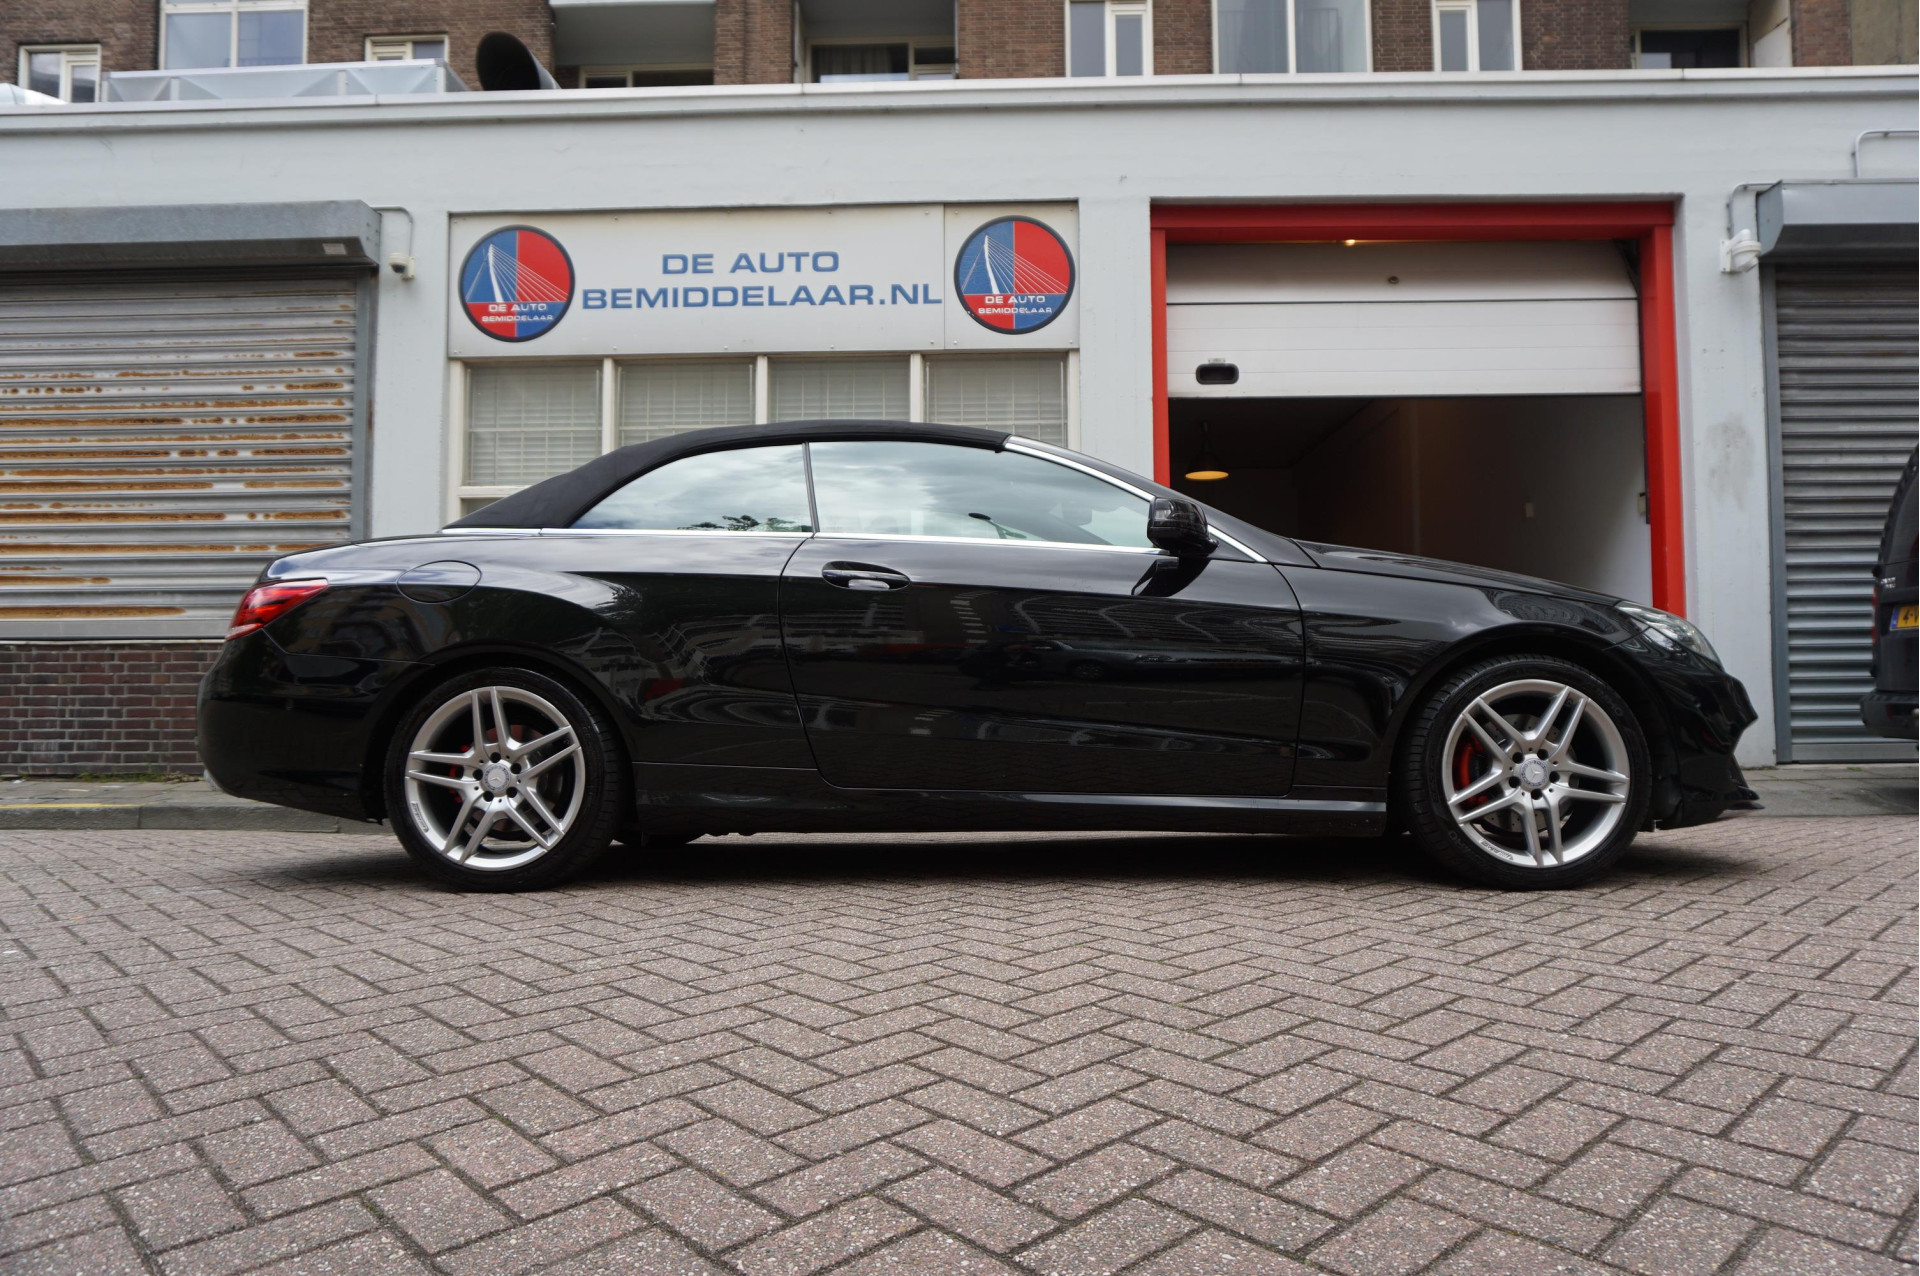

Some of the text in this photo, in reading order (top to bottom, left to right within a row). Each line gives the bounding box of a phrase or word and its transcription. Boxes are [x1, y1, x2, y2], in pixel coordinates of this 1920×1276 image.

[662, 251, 840, 275] DE AUTO
[582, 283, 943, 309] BEMIDDELAAR.NL
[985, 295, 1046, 304] DE AUTO
[488, 303, 547, 312] DE AUTO
[978, 306, 1053, 314] BEMIDDELAAR
[482, 314, 554, 322] BEMIDDELAAR
